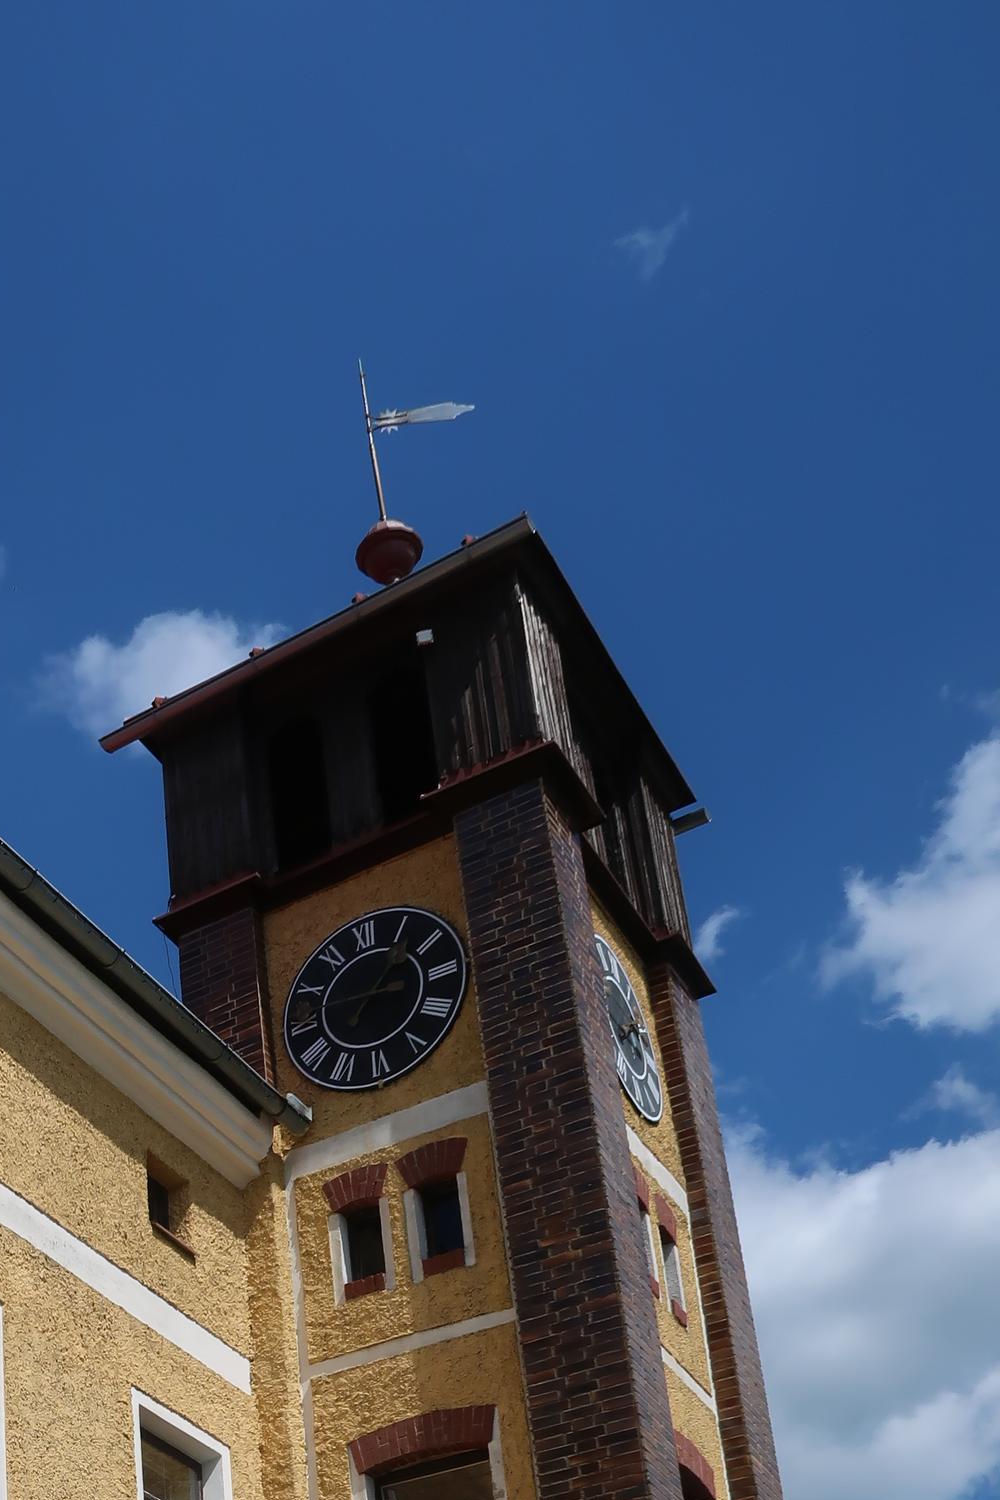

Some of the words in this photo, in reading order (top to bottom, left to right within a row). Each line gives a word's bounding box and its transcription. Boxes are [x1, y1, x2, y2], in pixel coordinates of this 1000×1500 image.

[352, 920, 375, 951] XII
[416, 929, 443, 956] II
[318, 944, 346, 972] XI
[428, 959, 457, 981] III
[296, 982, 324, 996] X
[300, 1036, 331, 1072] VIII
[405, 1031, 427, 1053] V
[330, 1052, 355, 1082] VII
[371, 1048, 391, 1078] VI
